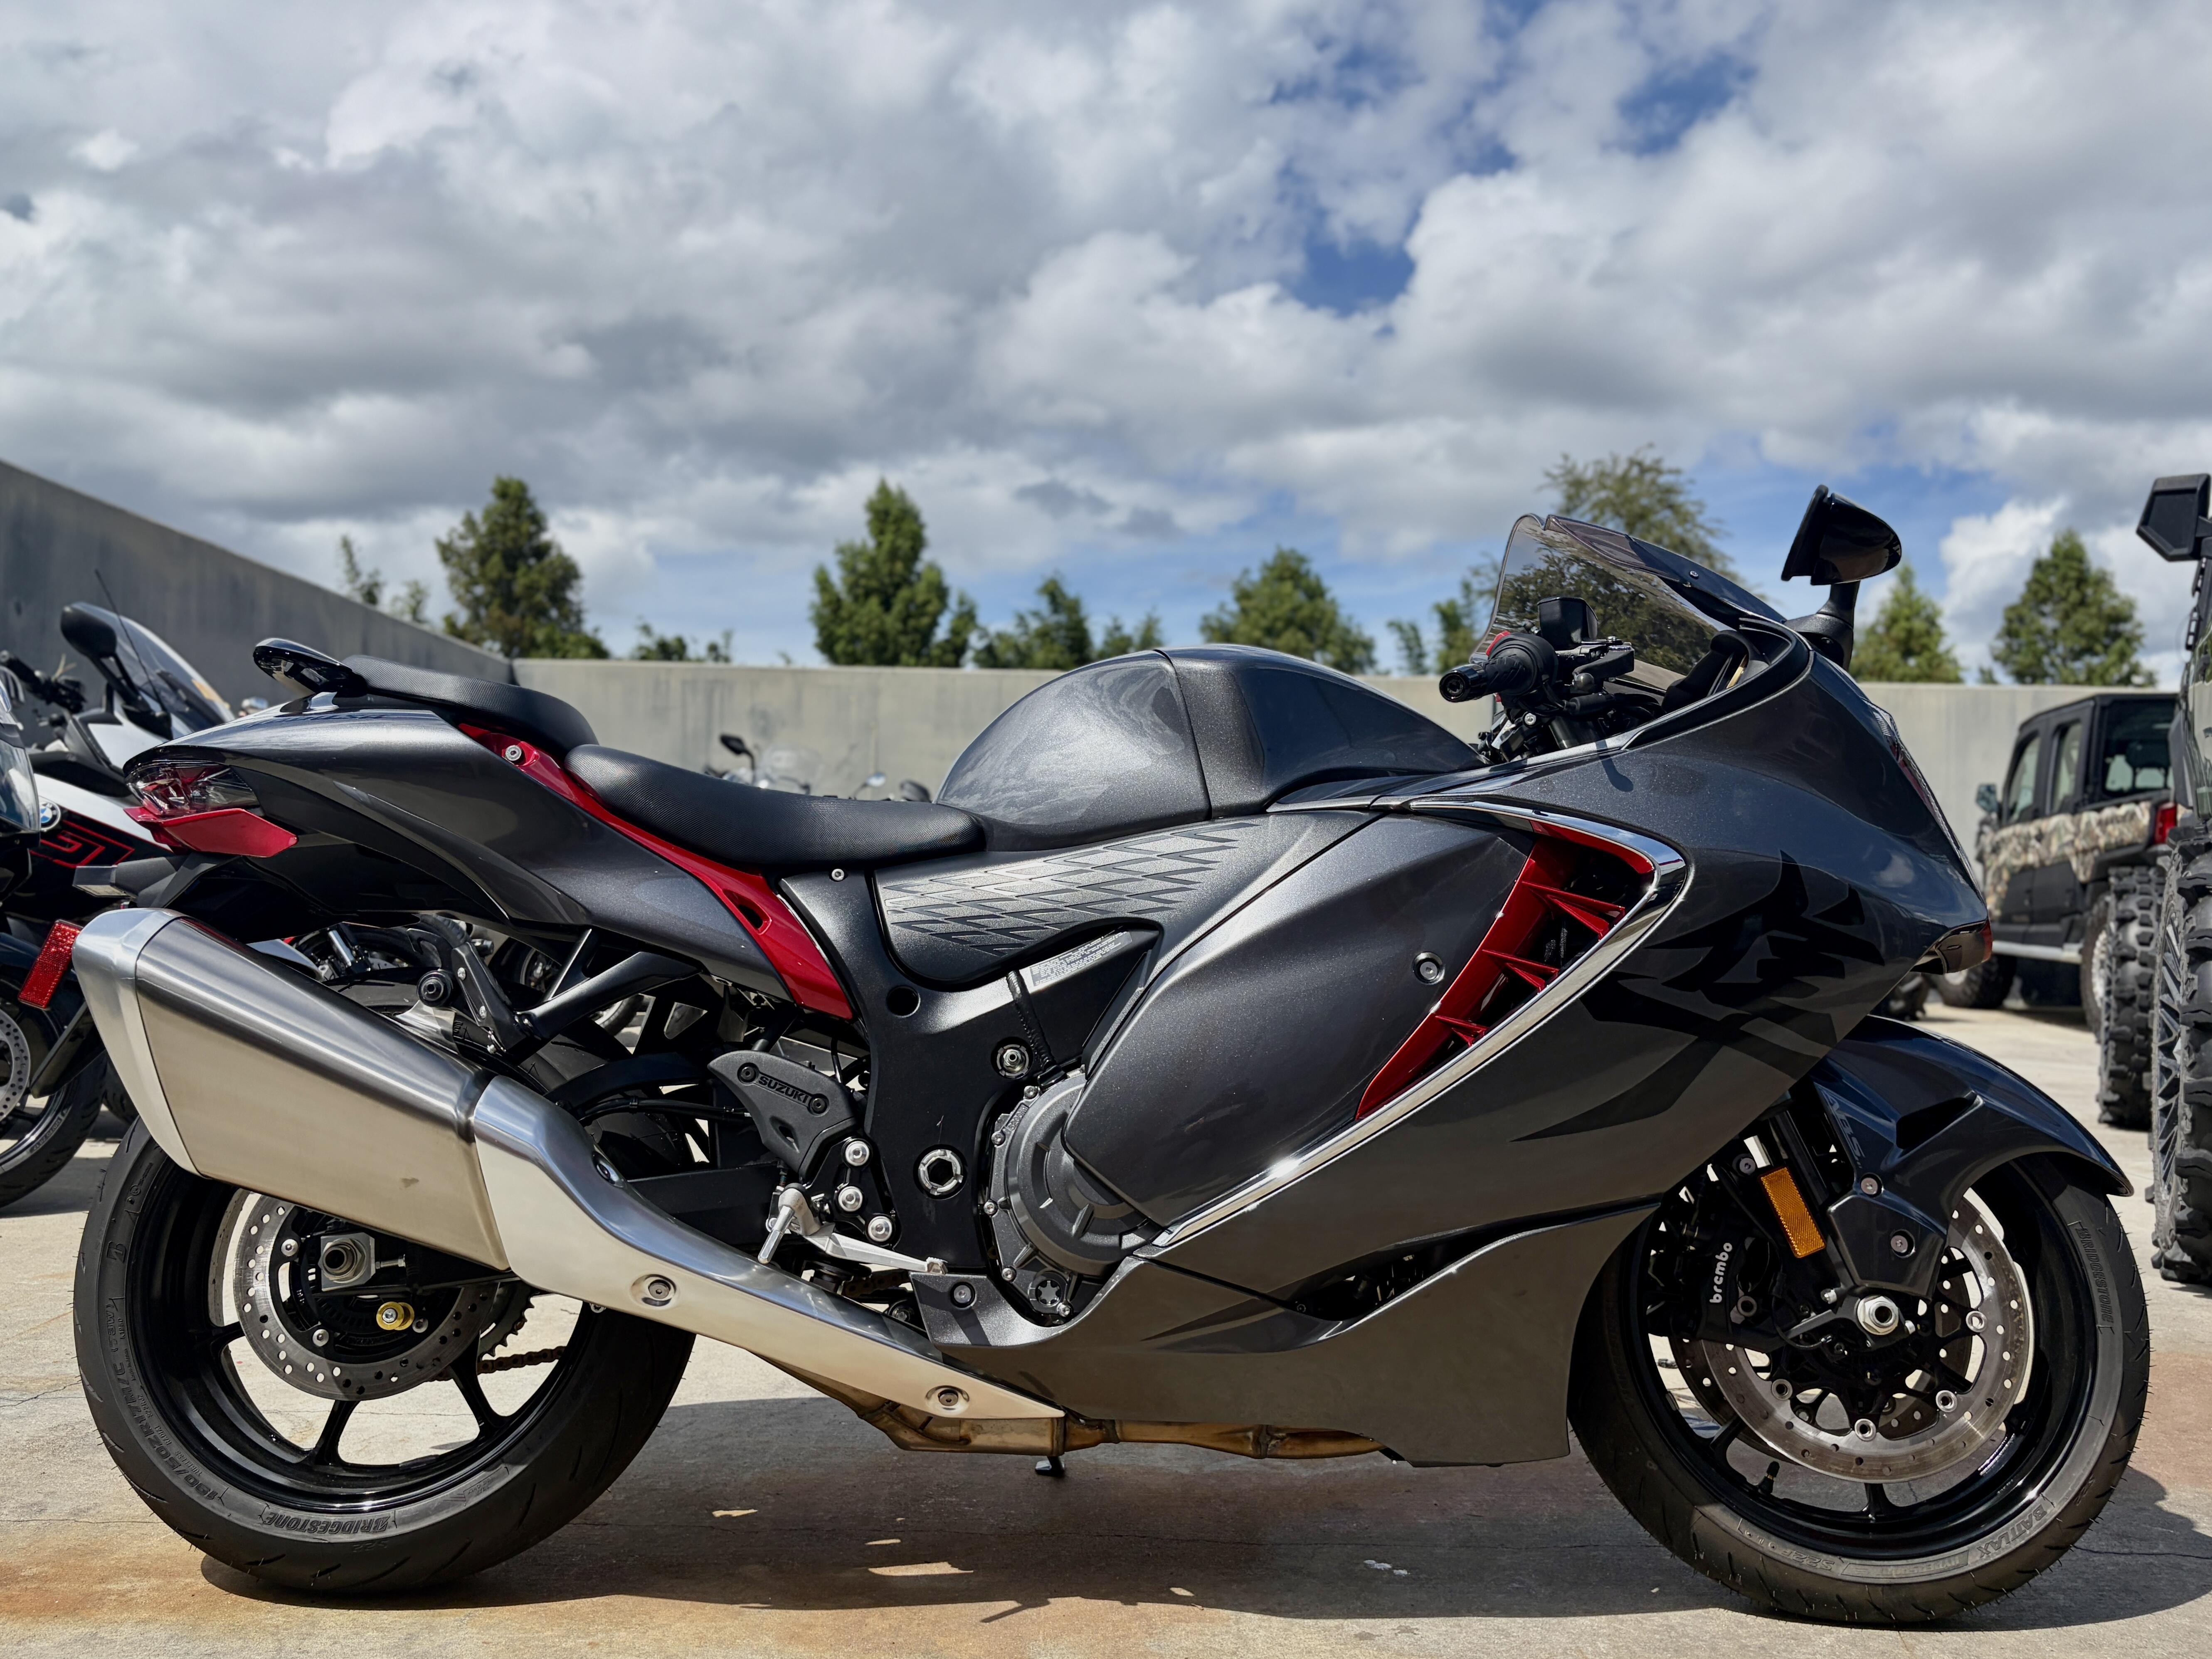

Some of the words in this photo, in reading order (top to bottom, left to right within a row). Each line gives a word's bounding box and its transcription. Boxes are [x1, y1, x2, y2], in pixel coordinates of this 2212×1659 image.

[759, 1076, 809, 1103] SUZUKI
[1824, 1092, 1866, 1158] ABS
[1709, 1242, 1733, 1303] brembo
[2075, 1228, 2114, 1323] BRIDGESTONE
[263, 1511, 390, 1536] BRIDGESTONE
[1976, 1504, 2049, 1558] BATTLAX
